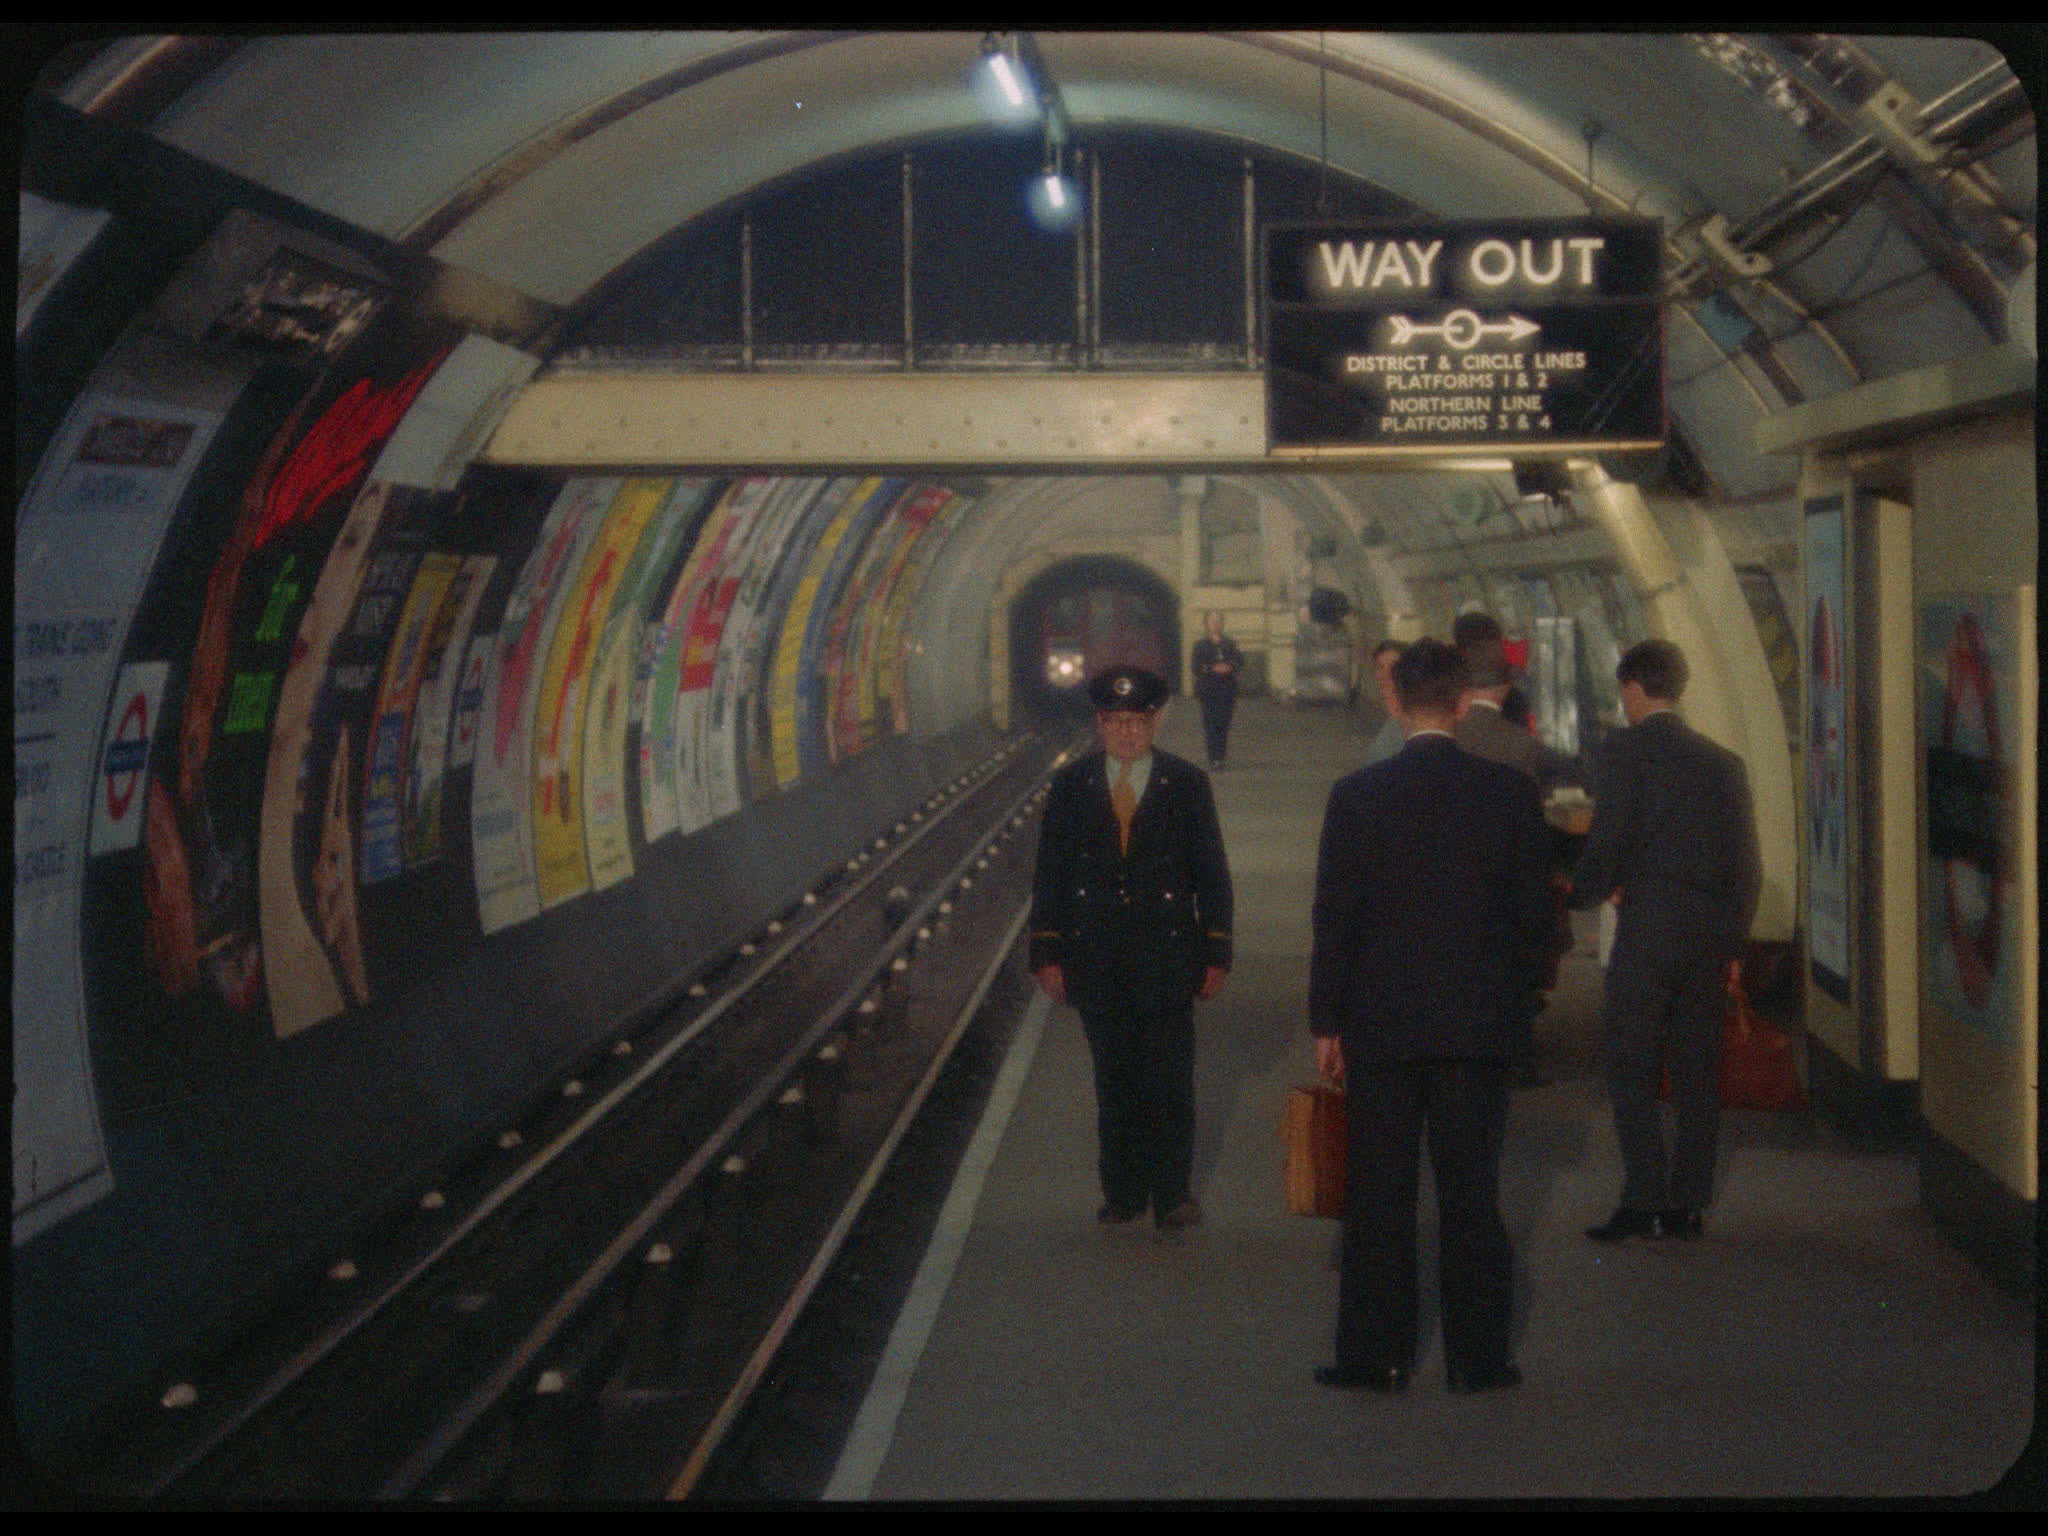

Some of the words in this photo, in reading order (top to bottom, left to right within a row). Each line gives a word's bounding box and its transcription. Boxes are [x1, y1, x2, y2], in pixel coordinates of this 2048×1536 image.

[1319, 240, 1444, 288] WAY
[1470, 238, 1605, 286] OUT
[1346, 355, 1429, 372] DISTRICT
[1438, 354, 1451, 371] &
[1462, 353, 1525, 370] CIRCLE
[1534, 352, 1586, 369] LINES
[1386, 374, 1494, 390] PLATFORMS
[1503, 373, 1510, 389] 1
[1516, 372, 1529, 389] &
[1537, 373, 1548, 389] 2
[1389, 396, 1491, 413] NORTHERN
[1502, 395, 1542, 411] LINE
[1381, 415, 1488, 432] PLATFORMS
[1498, 414, 1509, 430] 3
[1517, 414, 1530, 430] &
[1539, 415, 1552, 430] 4
